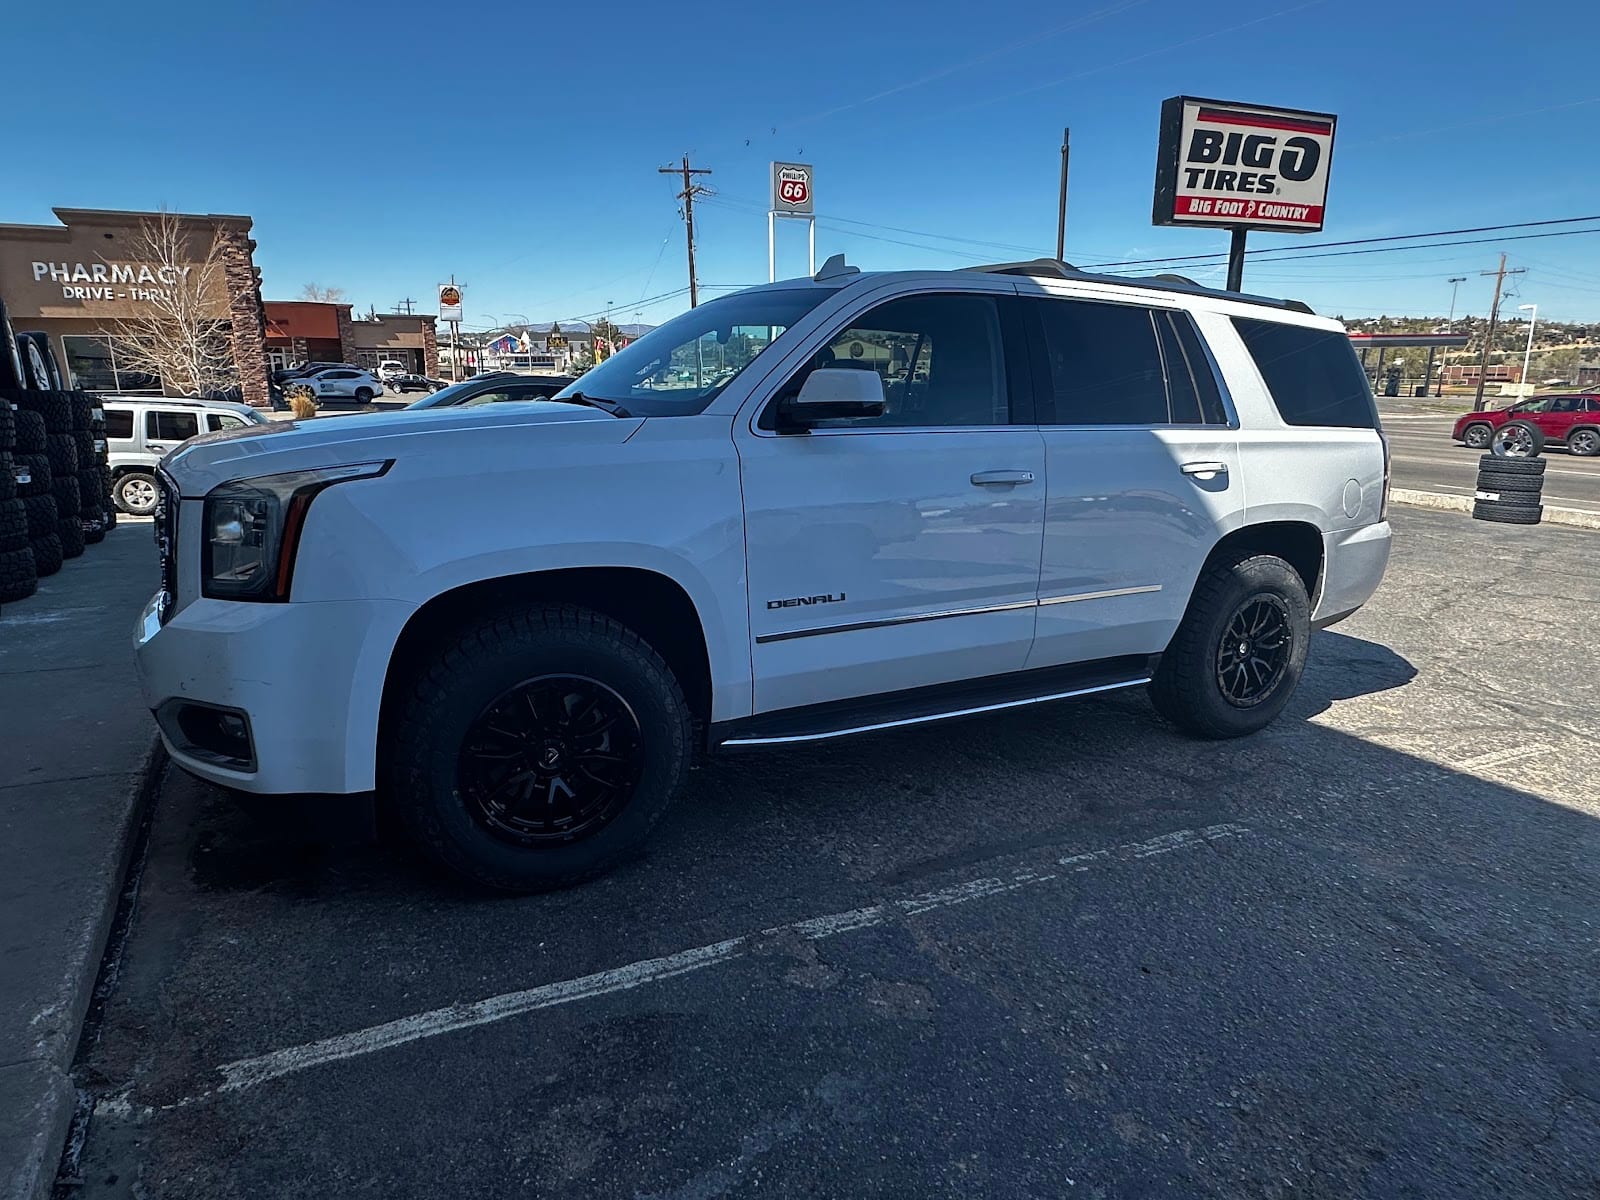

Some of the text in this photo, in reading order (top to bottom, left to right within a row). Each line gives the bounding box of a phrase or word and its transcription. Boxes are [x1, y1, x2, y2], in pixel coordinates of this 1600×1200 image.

[1187, 129, 1321, 182] BIG O
[783, 182, 804, 198] 66
[1184, 167, 1277, 195] TIRES
[1189, 198, 1310, 220] BIG FOOT COUNTRY
[31, 261, 191, 286] PHARMACY
[62, 286, 114, 300] DRIVE
[767, 592, 846, 610] DENALI
